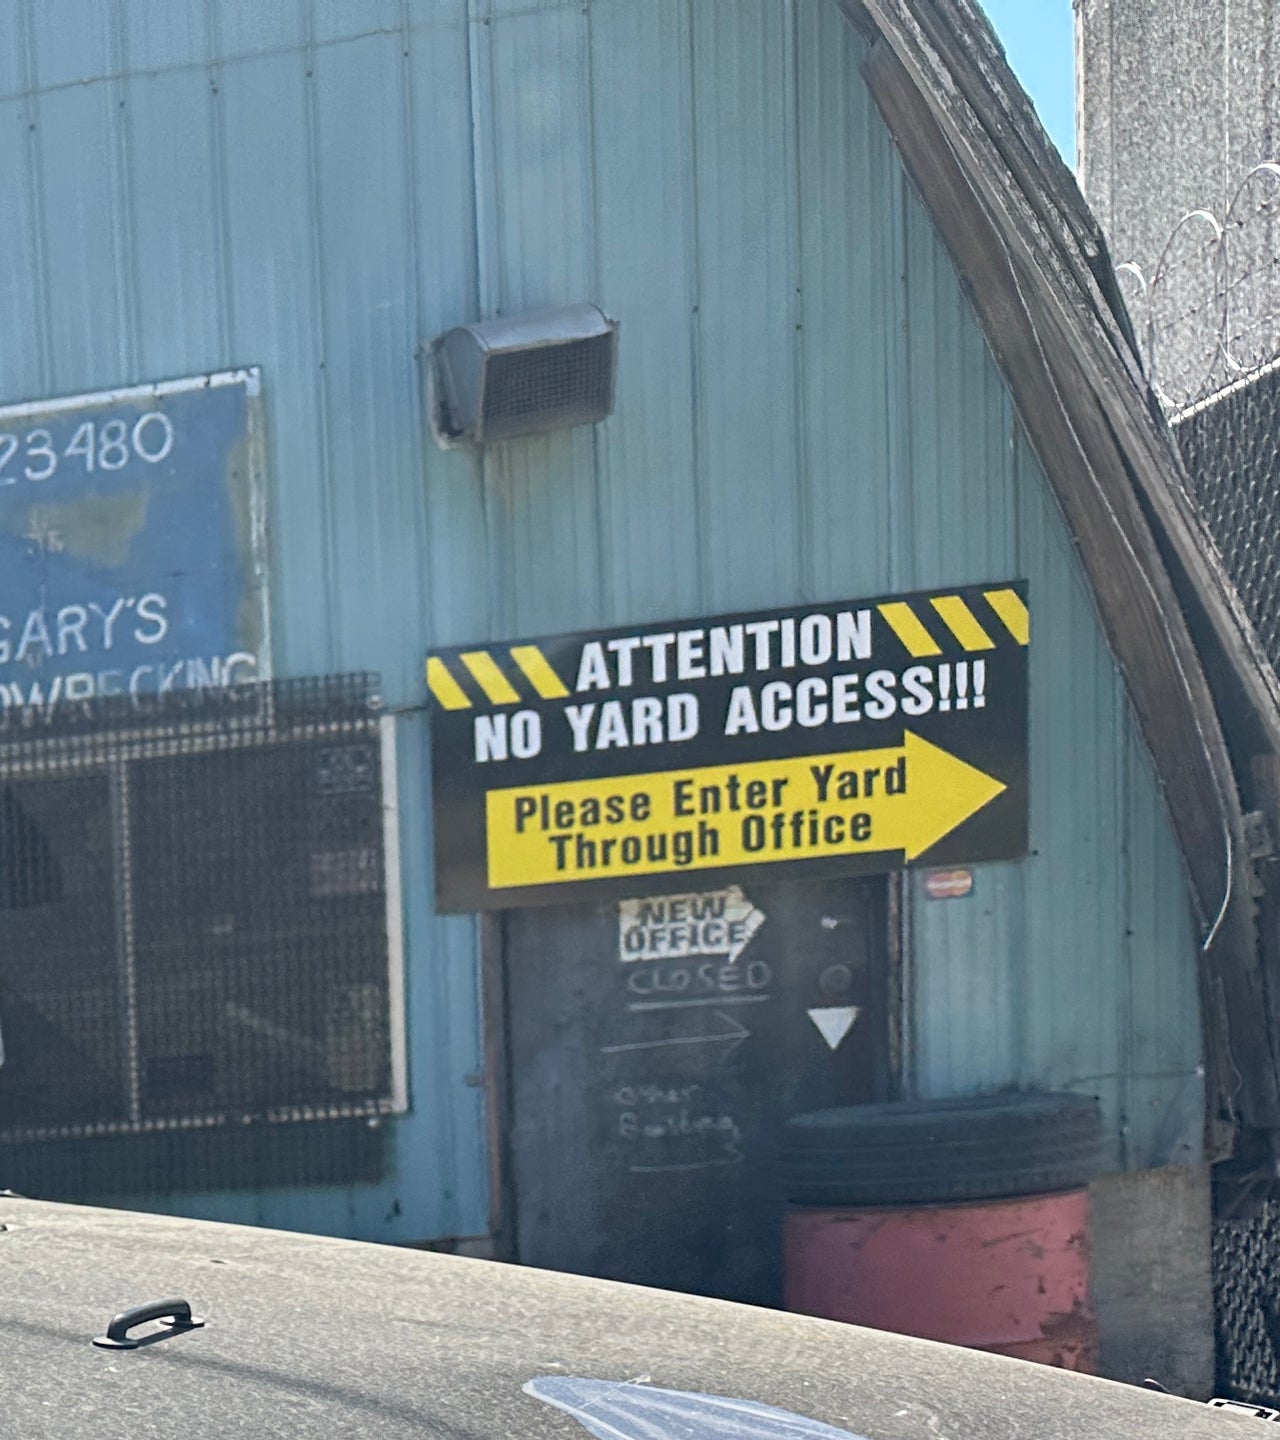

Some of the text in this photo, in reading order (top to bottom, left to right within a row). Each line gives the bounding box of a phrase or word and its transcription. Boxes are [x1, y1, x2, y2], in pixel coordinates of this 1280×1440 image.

[576, 608, 873, 692] ATTENTION
[473, 658, 987, 763] NO YARD ACCESS!!!
[513, 757, 908, 834] Please Enter Yard
[548, 809, 873, 872] Through Office
[624, 919, 746, 954] OFFICE
[640, 895, 726, 926] NEW
